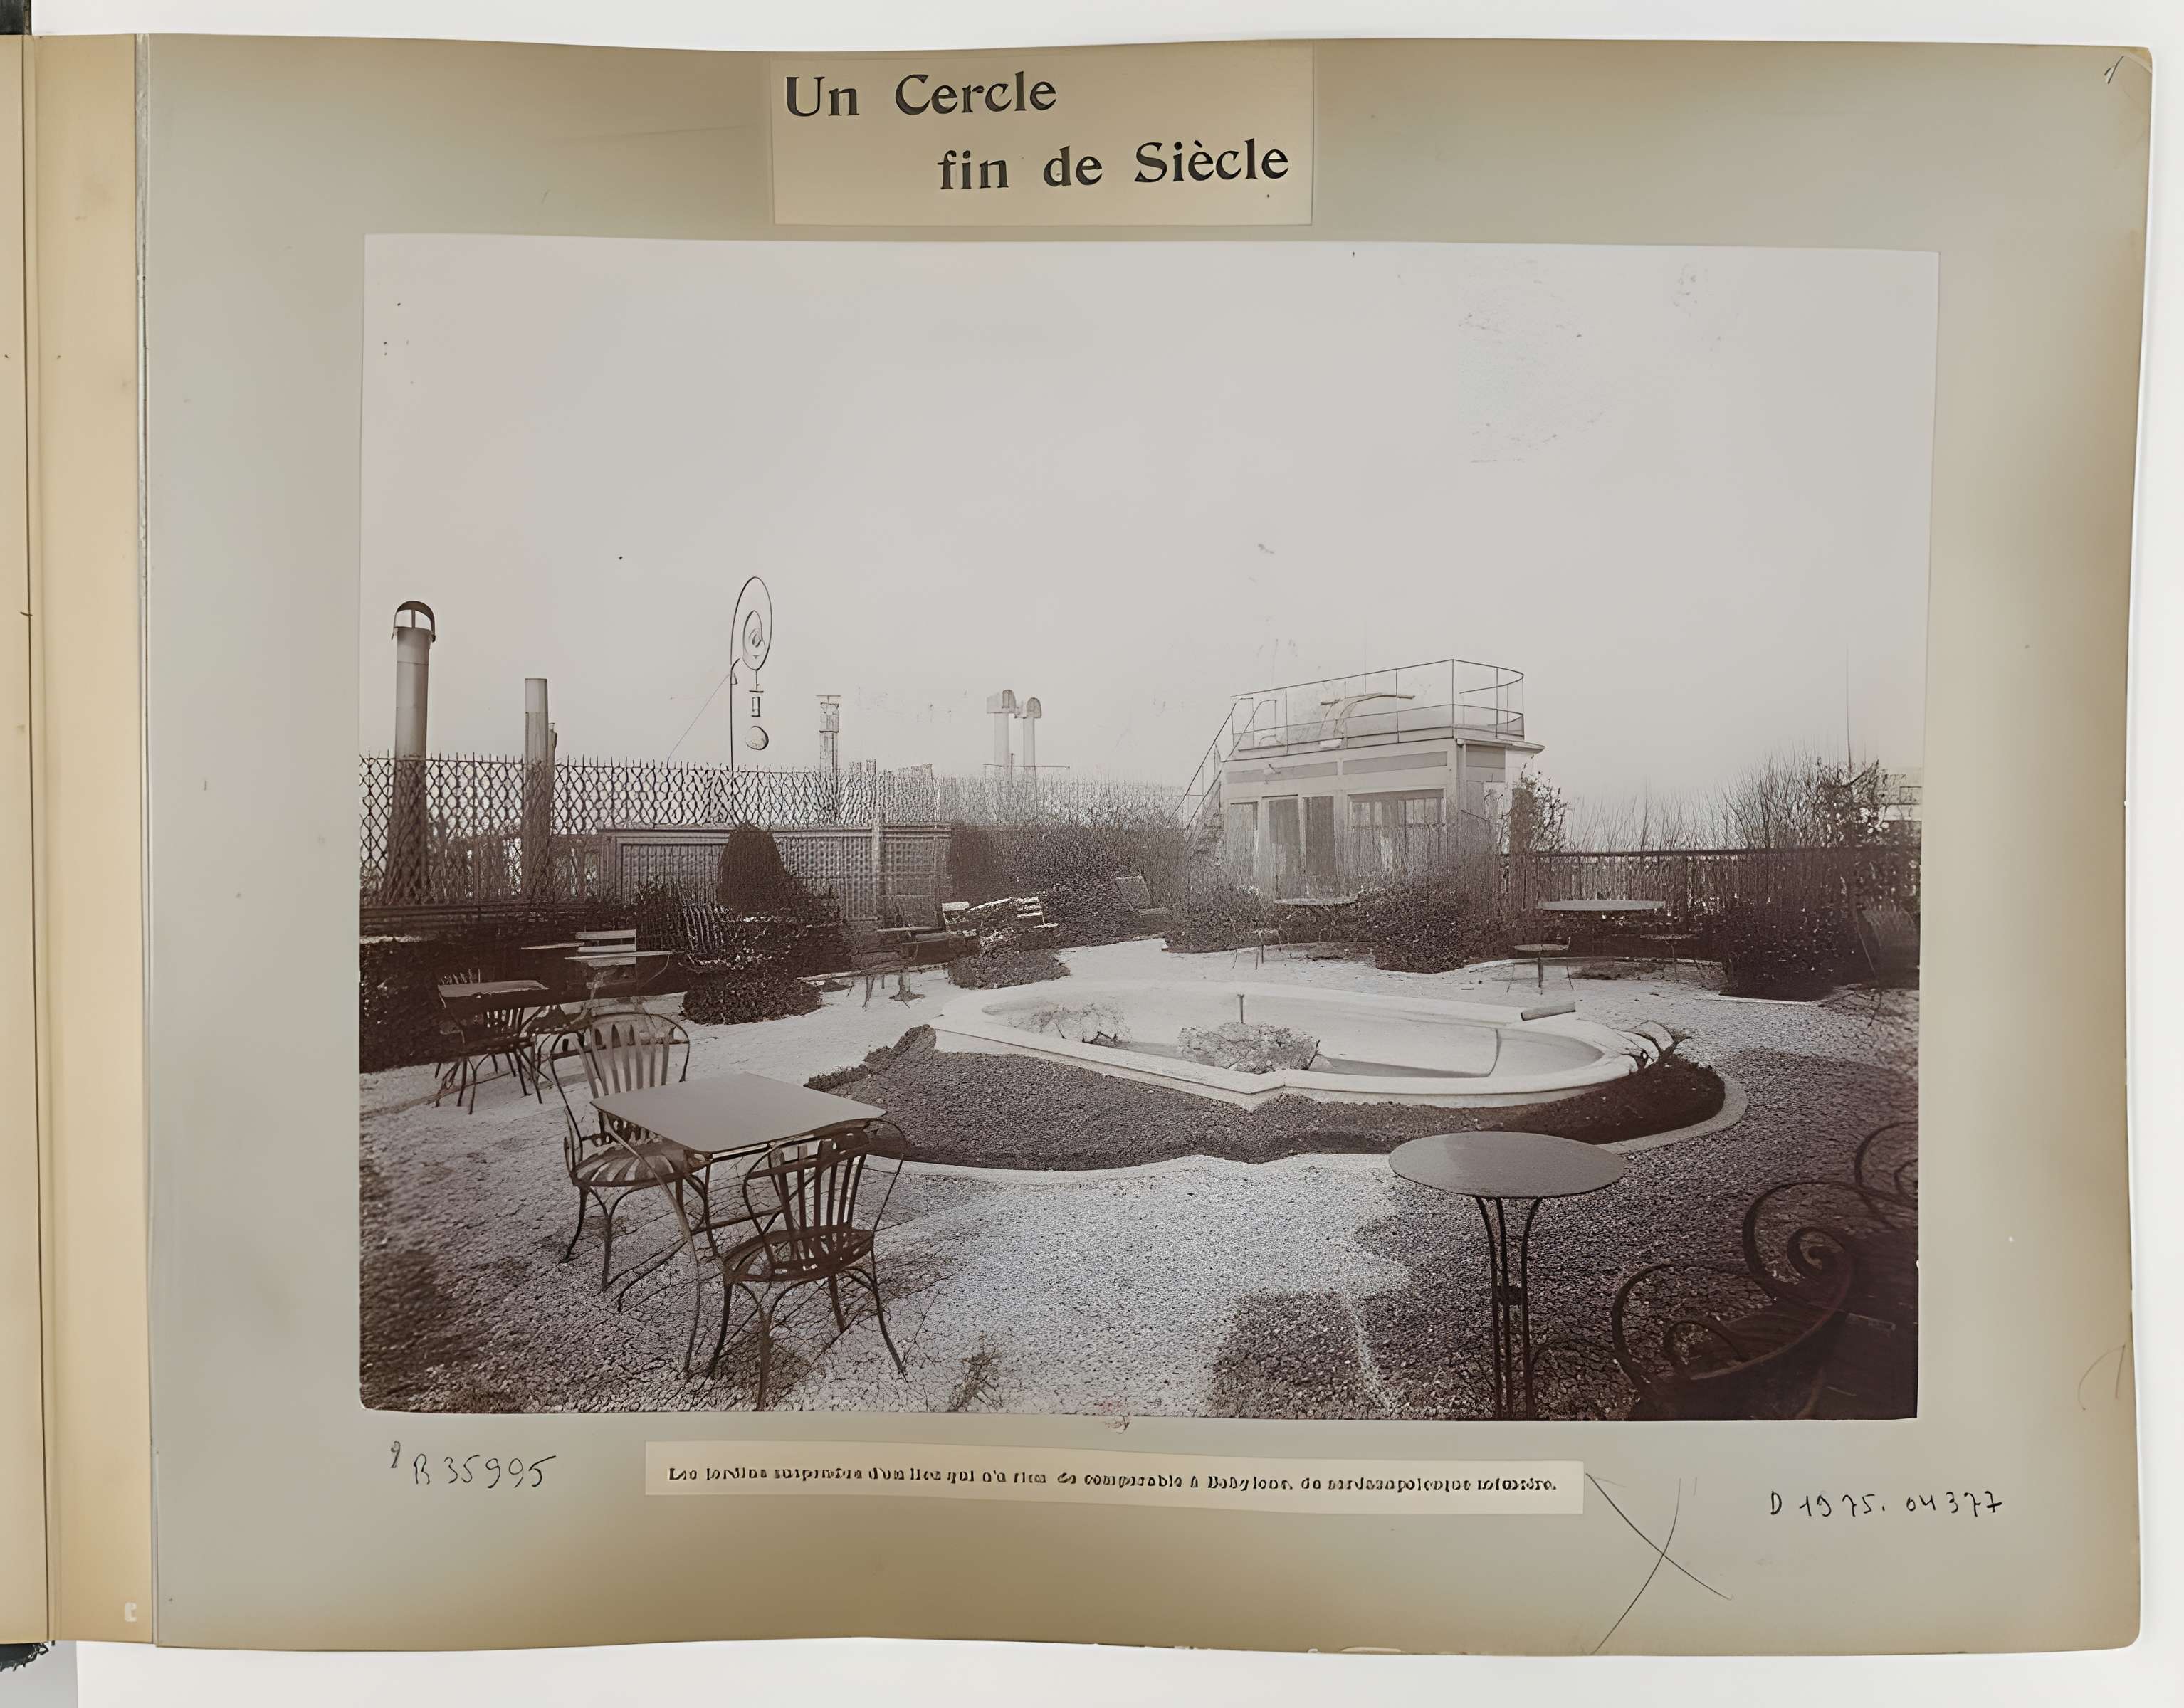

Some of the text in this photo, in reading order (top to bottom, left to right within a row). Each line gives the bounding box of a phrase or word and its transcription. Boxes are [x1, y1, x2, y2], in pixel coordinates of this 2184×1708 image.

[785, 70, 1057, 117] Un Cercle
[936, 137, 1289, 190] fin de Siècle
[1770, 1490, 1783, 1516] D
